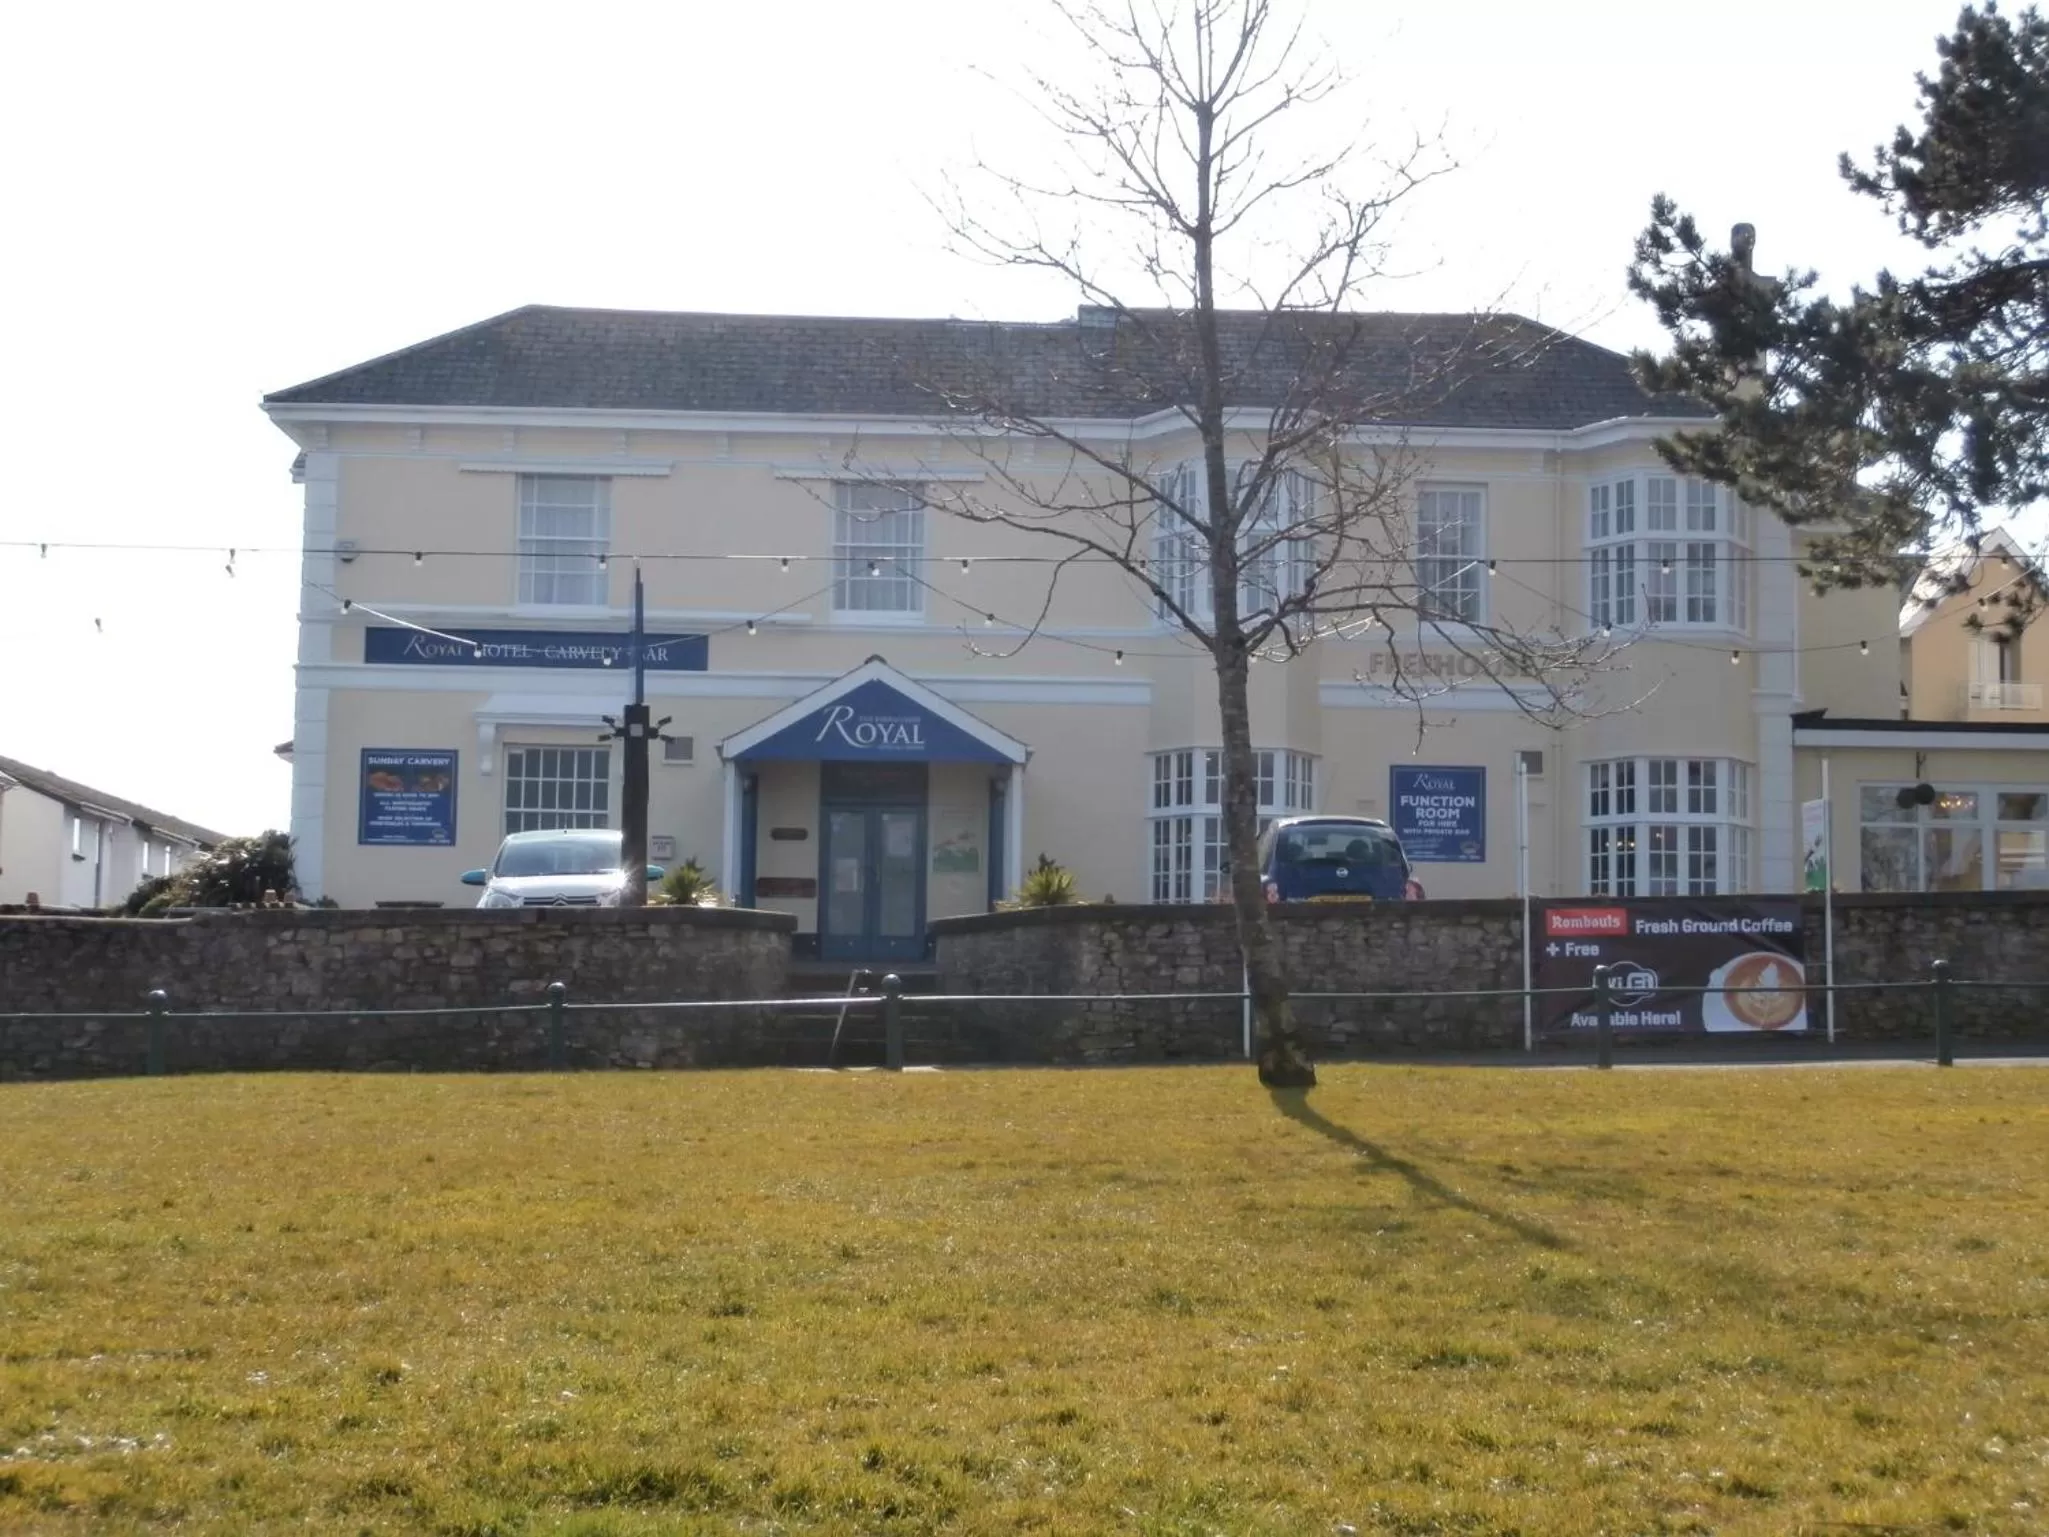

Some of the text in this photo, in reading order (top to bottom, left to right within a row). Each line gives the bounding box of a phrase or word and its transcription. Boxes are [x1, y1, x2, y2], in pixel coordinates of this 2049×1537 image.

[640, 647, 669, 661] AR
[815, 704, 925, 748] ROYAL
[1400, 795, 1475, 807] FUNCTION
[1415, 808, 1460, 819] ROOM
[1418, 819, 1435, 828] FOR
[1551, 914, 1794, 934] Rombouts Fresh Ground Coffee
[1565, 942, 1600, 957] Free
[1570, 1010, 1682, 1027] Avaable Here!
